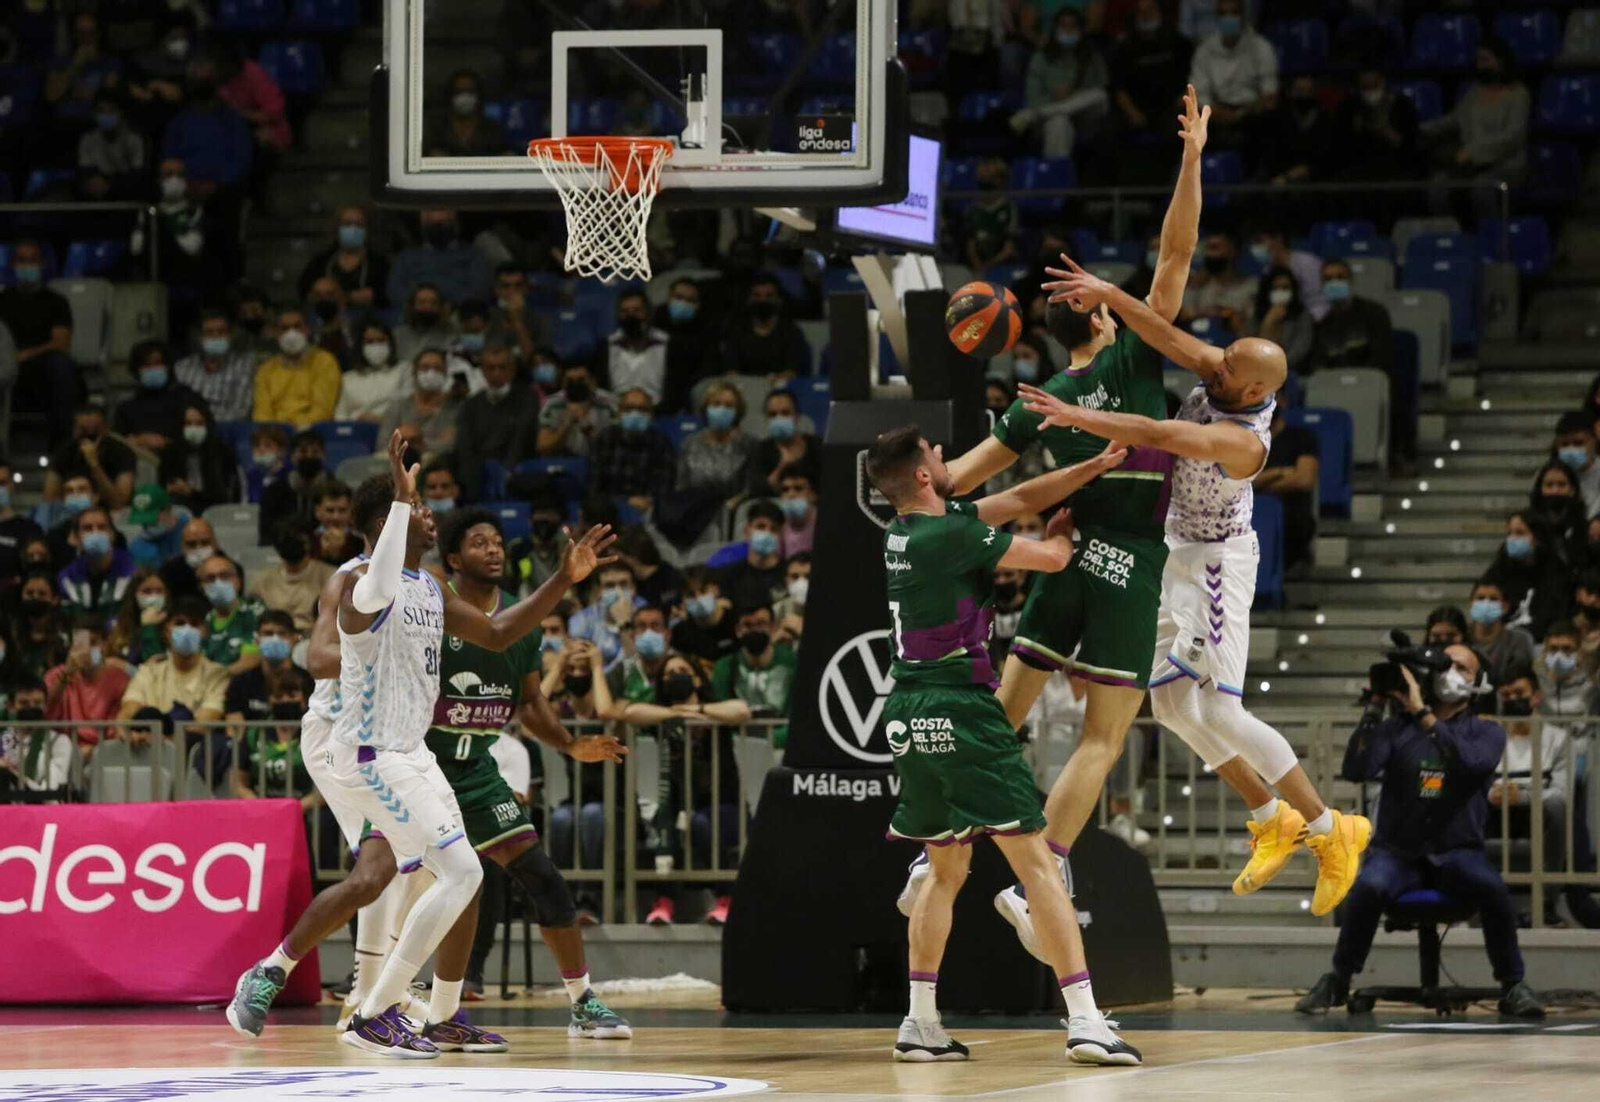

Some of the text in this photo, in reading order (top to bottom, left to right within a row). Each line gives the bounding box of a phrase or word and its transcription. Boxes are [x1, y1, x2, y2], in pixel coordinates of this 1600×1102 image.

[799, 126, 823, 140] liga
[799, 138, 851, 150] endesa
[1088, 539, 1135, 568] COSTA
[1083, 551, 1131, 579] DEL SOL
[424, 646, 438, 676] 31
[478, 682, 513, 696] Unicaja
[910, 718, 953, 731] COSTA
[454, 733, 473, 761] 0
[912, 731, 956, 743] DEL SOL
[793, 773, 882, 801] Málaga
